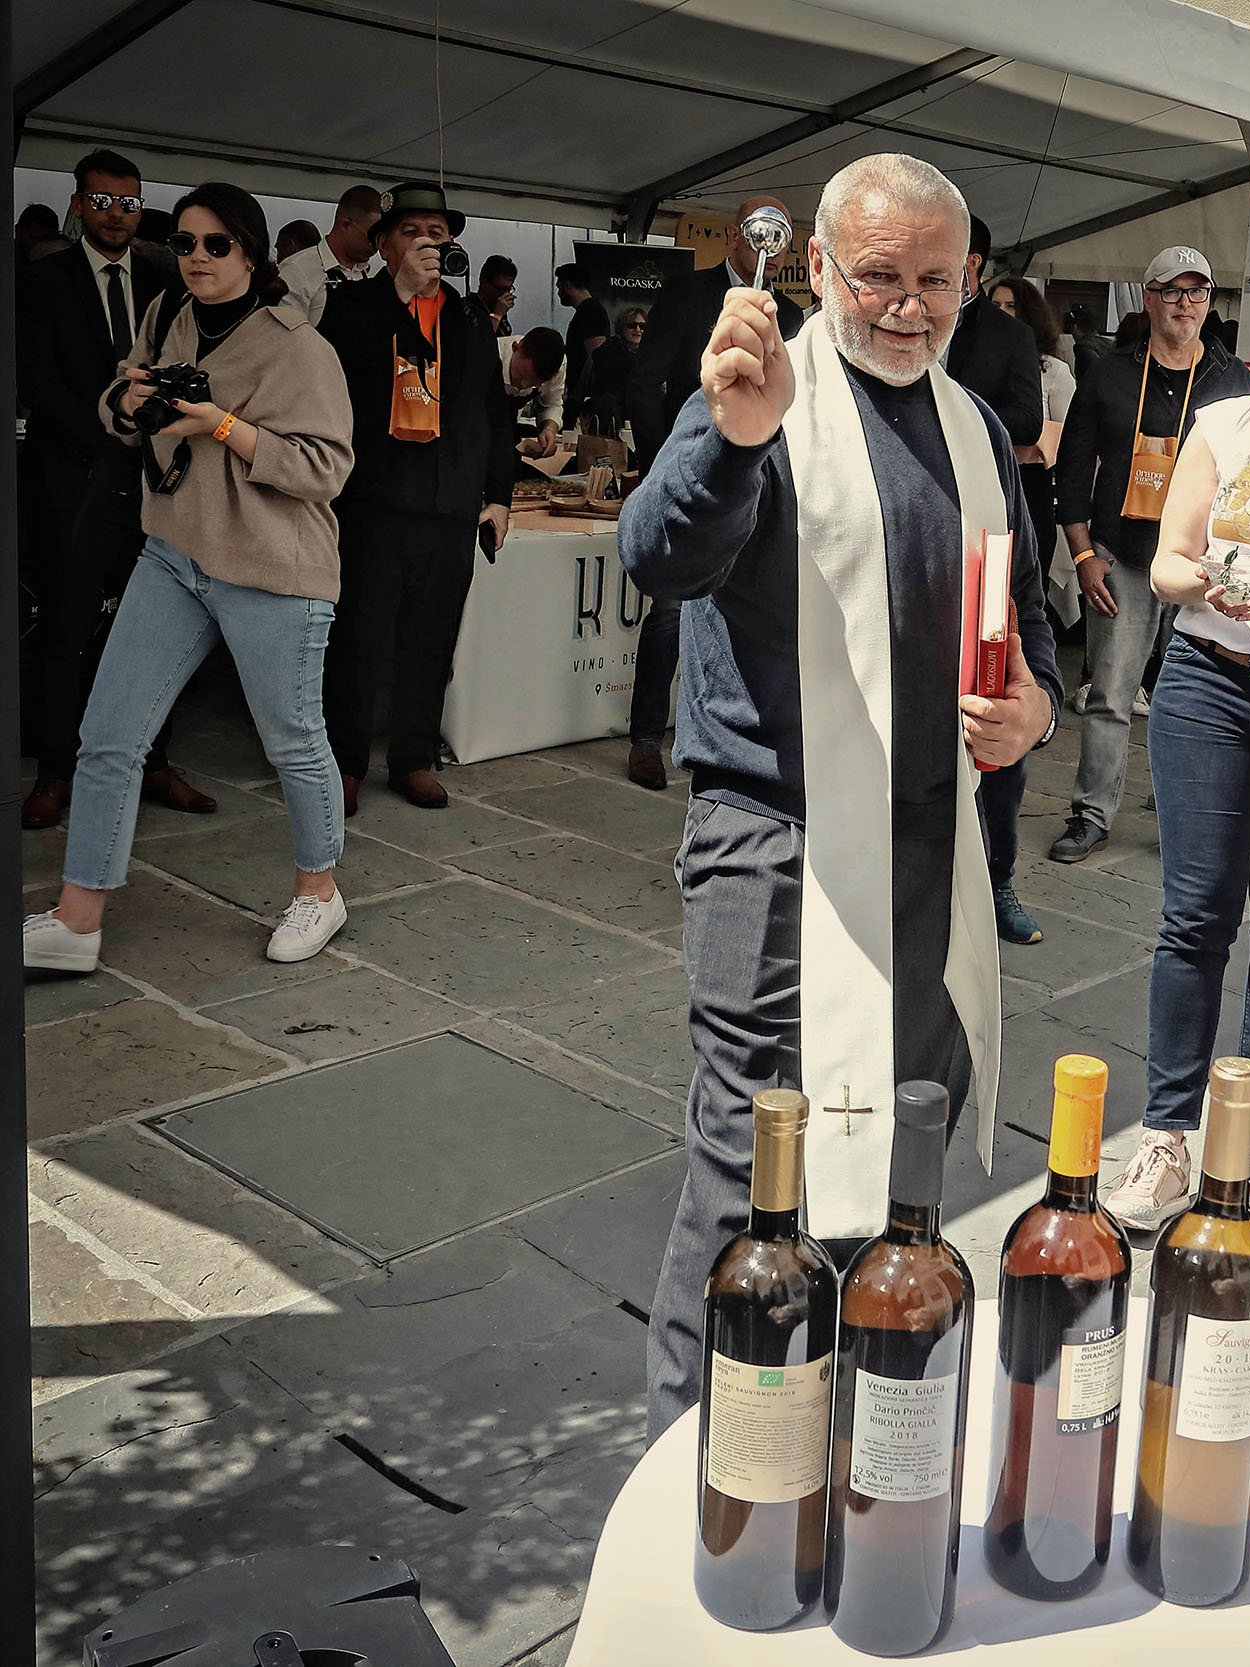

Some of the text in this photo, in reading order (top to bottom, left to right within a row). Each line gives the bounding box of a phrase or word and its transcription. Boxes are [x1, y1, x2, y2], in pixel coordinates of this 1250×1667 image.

[165, 469, 180, 487] Nikon
[1135, 470, 1166, 480] orange
[573, 656, 604, 672] VINO
[605, 682, 635, 694] Šmars
[1084, 1326, 1115, 1342] PRUS
[1203, 1366, 1228, 1374] KRAS
[736, 1387, 777, 1396] SAUVIGNON
[866, 1378, 944, 1396] Venezia Giulia
[874, 1403, 936, 1416] Dario Prinčič
[869, 1415, 936, 1428] RIBOLLA GIALLA
[1062, 1424, 1080, 1432] 0,75
[890, 1431, 918, 1439] 2018
[854, 1465, 893, 1483] 12,5% vol
[913, 1473, 929, 1483] 750
